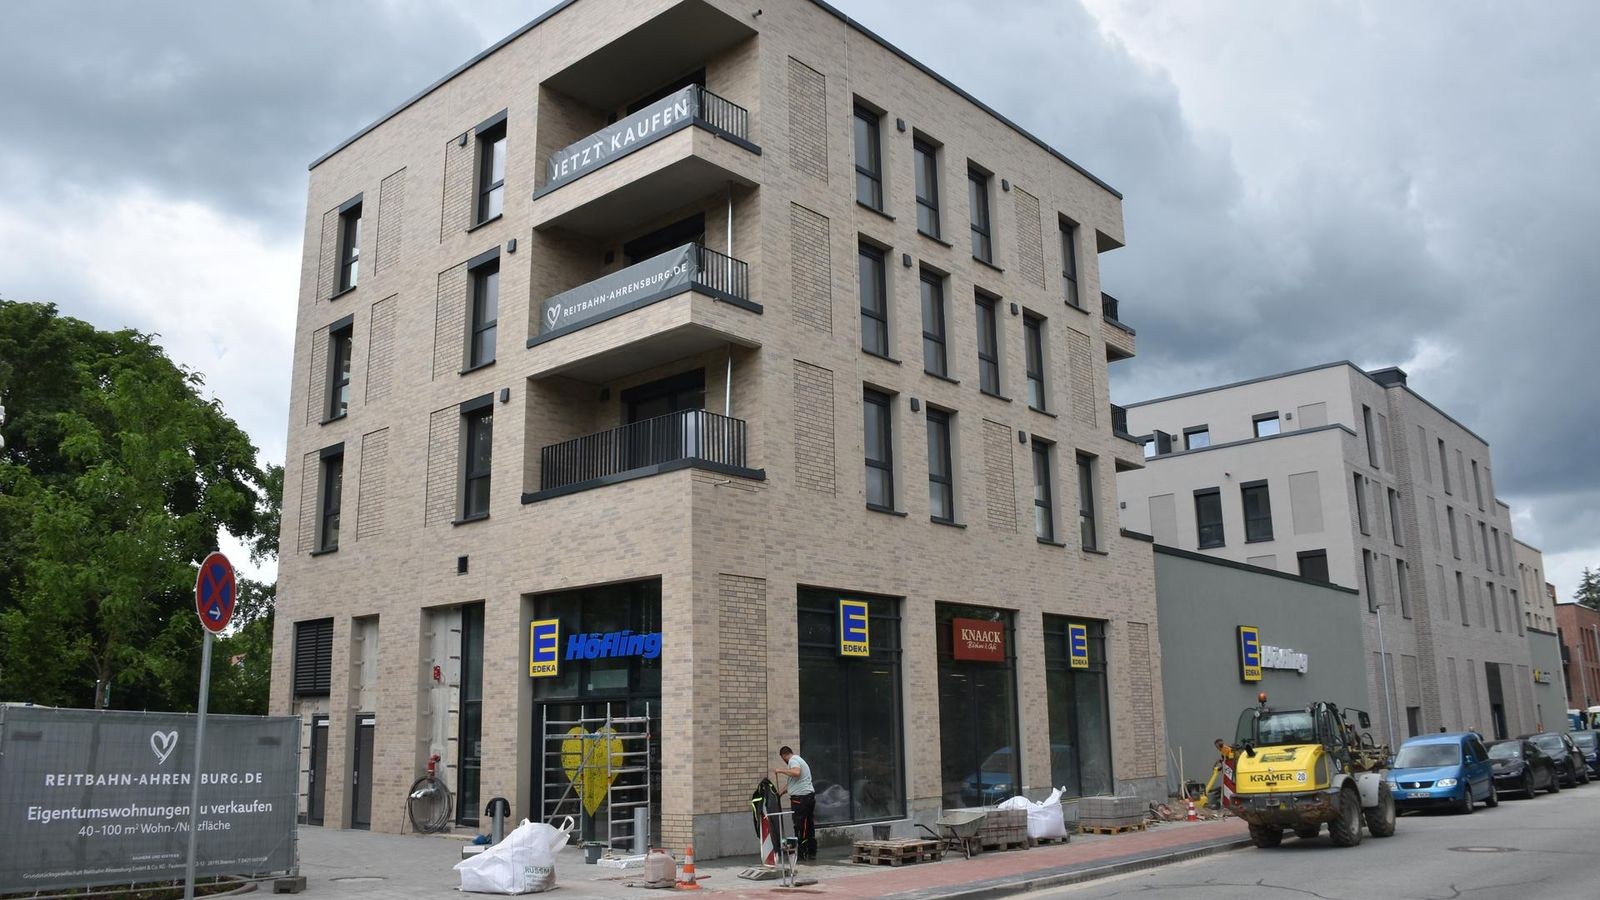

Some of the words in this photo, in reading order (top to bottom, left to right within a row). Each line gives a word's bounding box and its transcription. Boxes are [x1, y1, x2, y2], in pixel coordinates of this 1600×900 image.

[552, 141, 604, 181] JETZT
[611, 98, 688, 152] KAUFEN
[563, 262, 688, 318] REITBAHN-AHRENSBURG.DE
[961, 628, 1001, 643] KNAACK
[565, 629, 663, 661] Höfling
[843, 644, 868, 654] EDEKA
[532, 664, 556, 673] EDEKA
[45, 772, 263, 786] REITBAHN-AHRENBURG.DE
[1250, 773, 1293, 783] KRAMER
[27, 803, 190, 824] Eigentumswohnungen
[210, 799, 273, 814] verkaufen
[141, 819, 231, 834] Wohn-/Nzfläche
